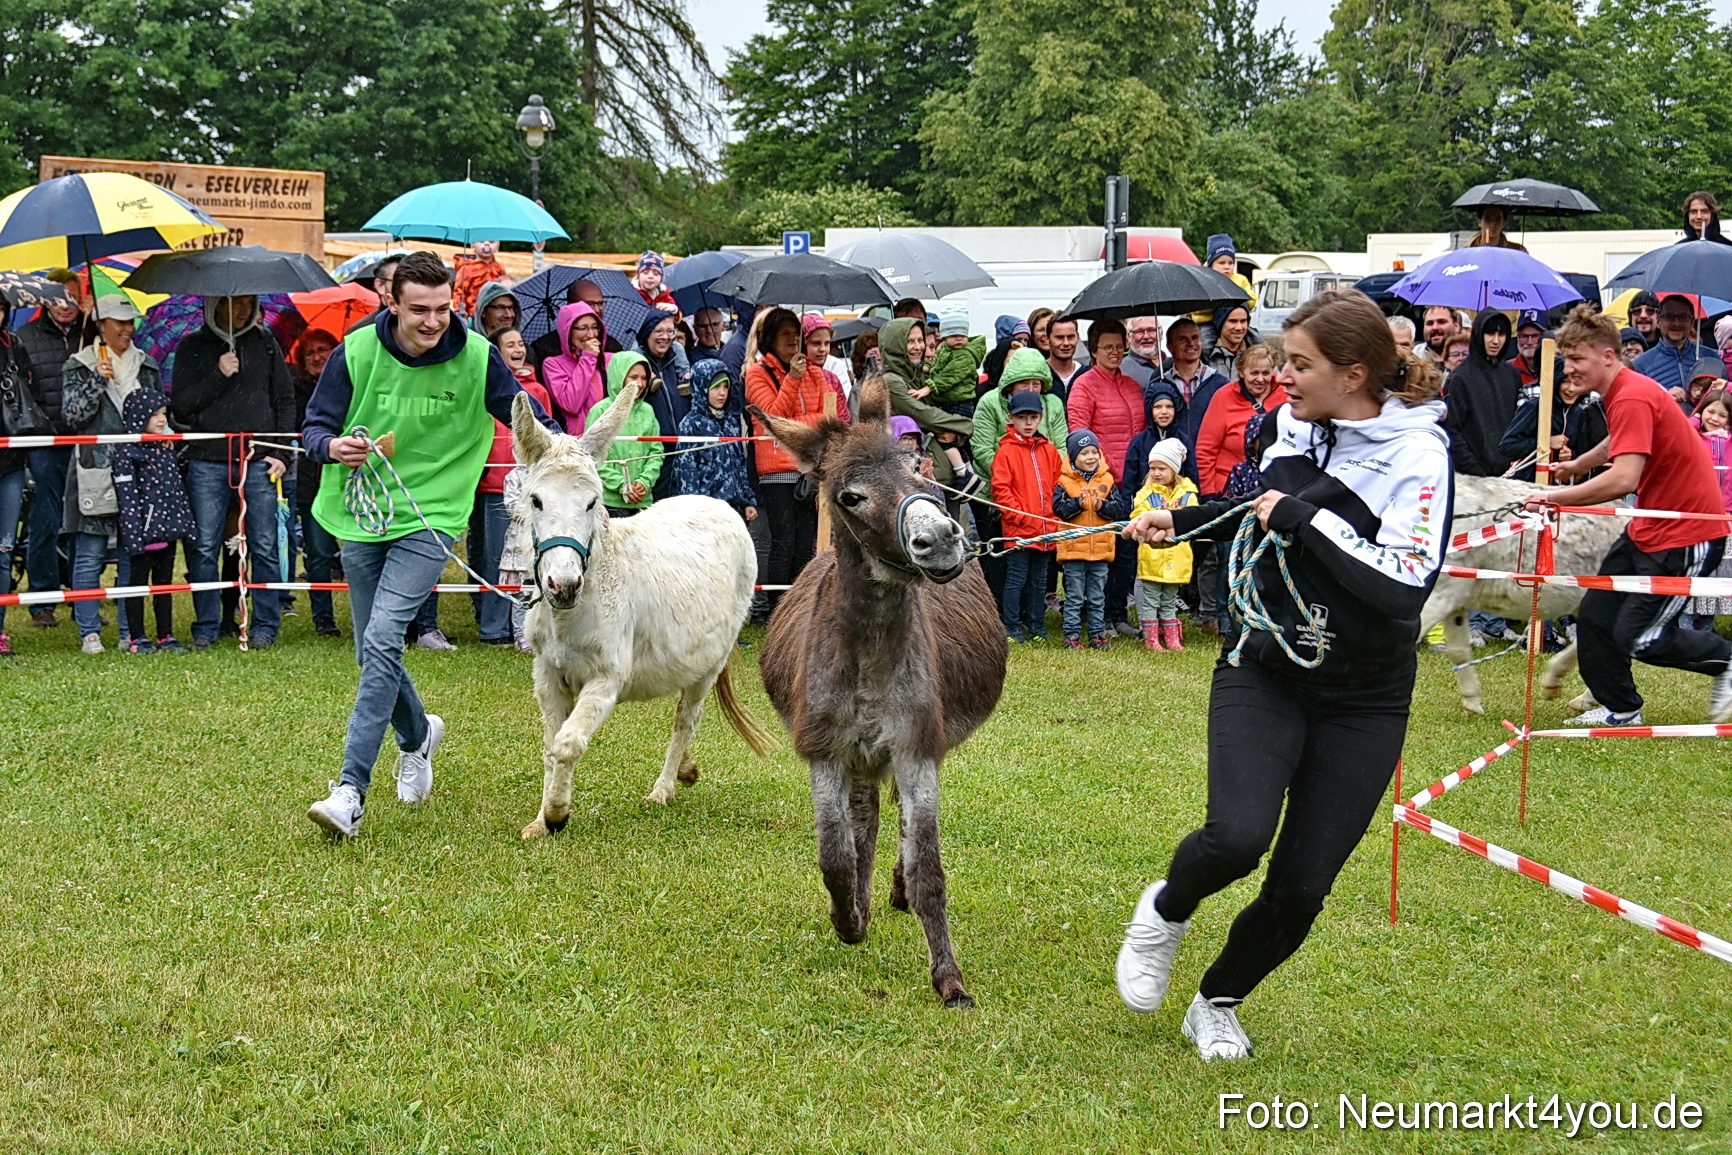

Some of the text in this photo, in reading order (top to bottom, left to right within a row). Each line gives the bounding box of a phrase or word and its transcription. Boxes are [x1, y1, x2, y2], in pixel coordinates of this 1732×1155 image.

[205, 175, 309, 196] ESELVERLEIH
[789, 235, 804, 255] P
[1442, 264, 1479, 276] Milka
